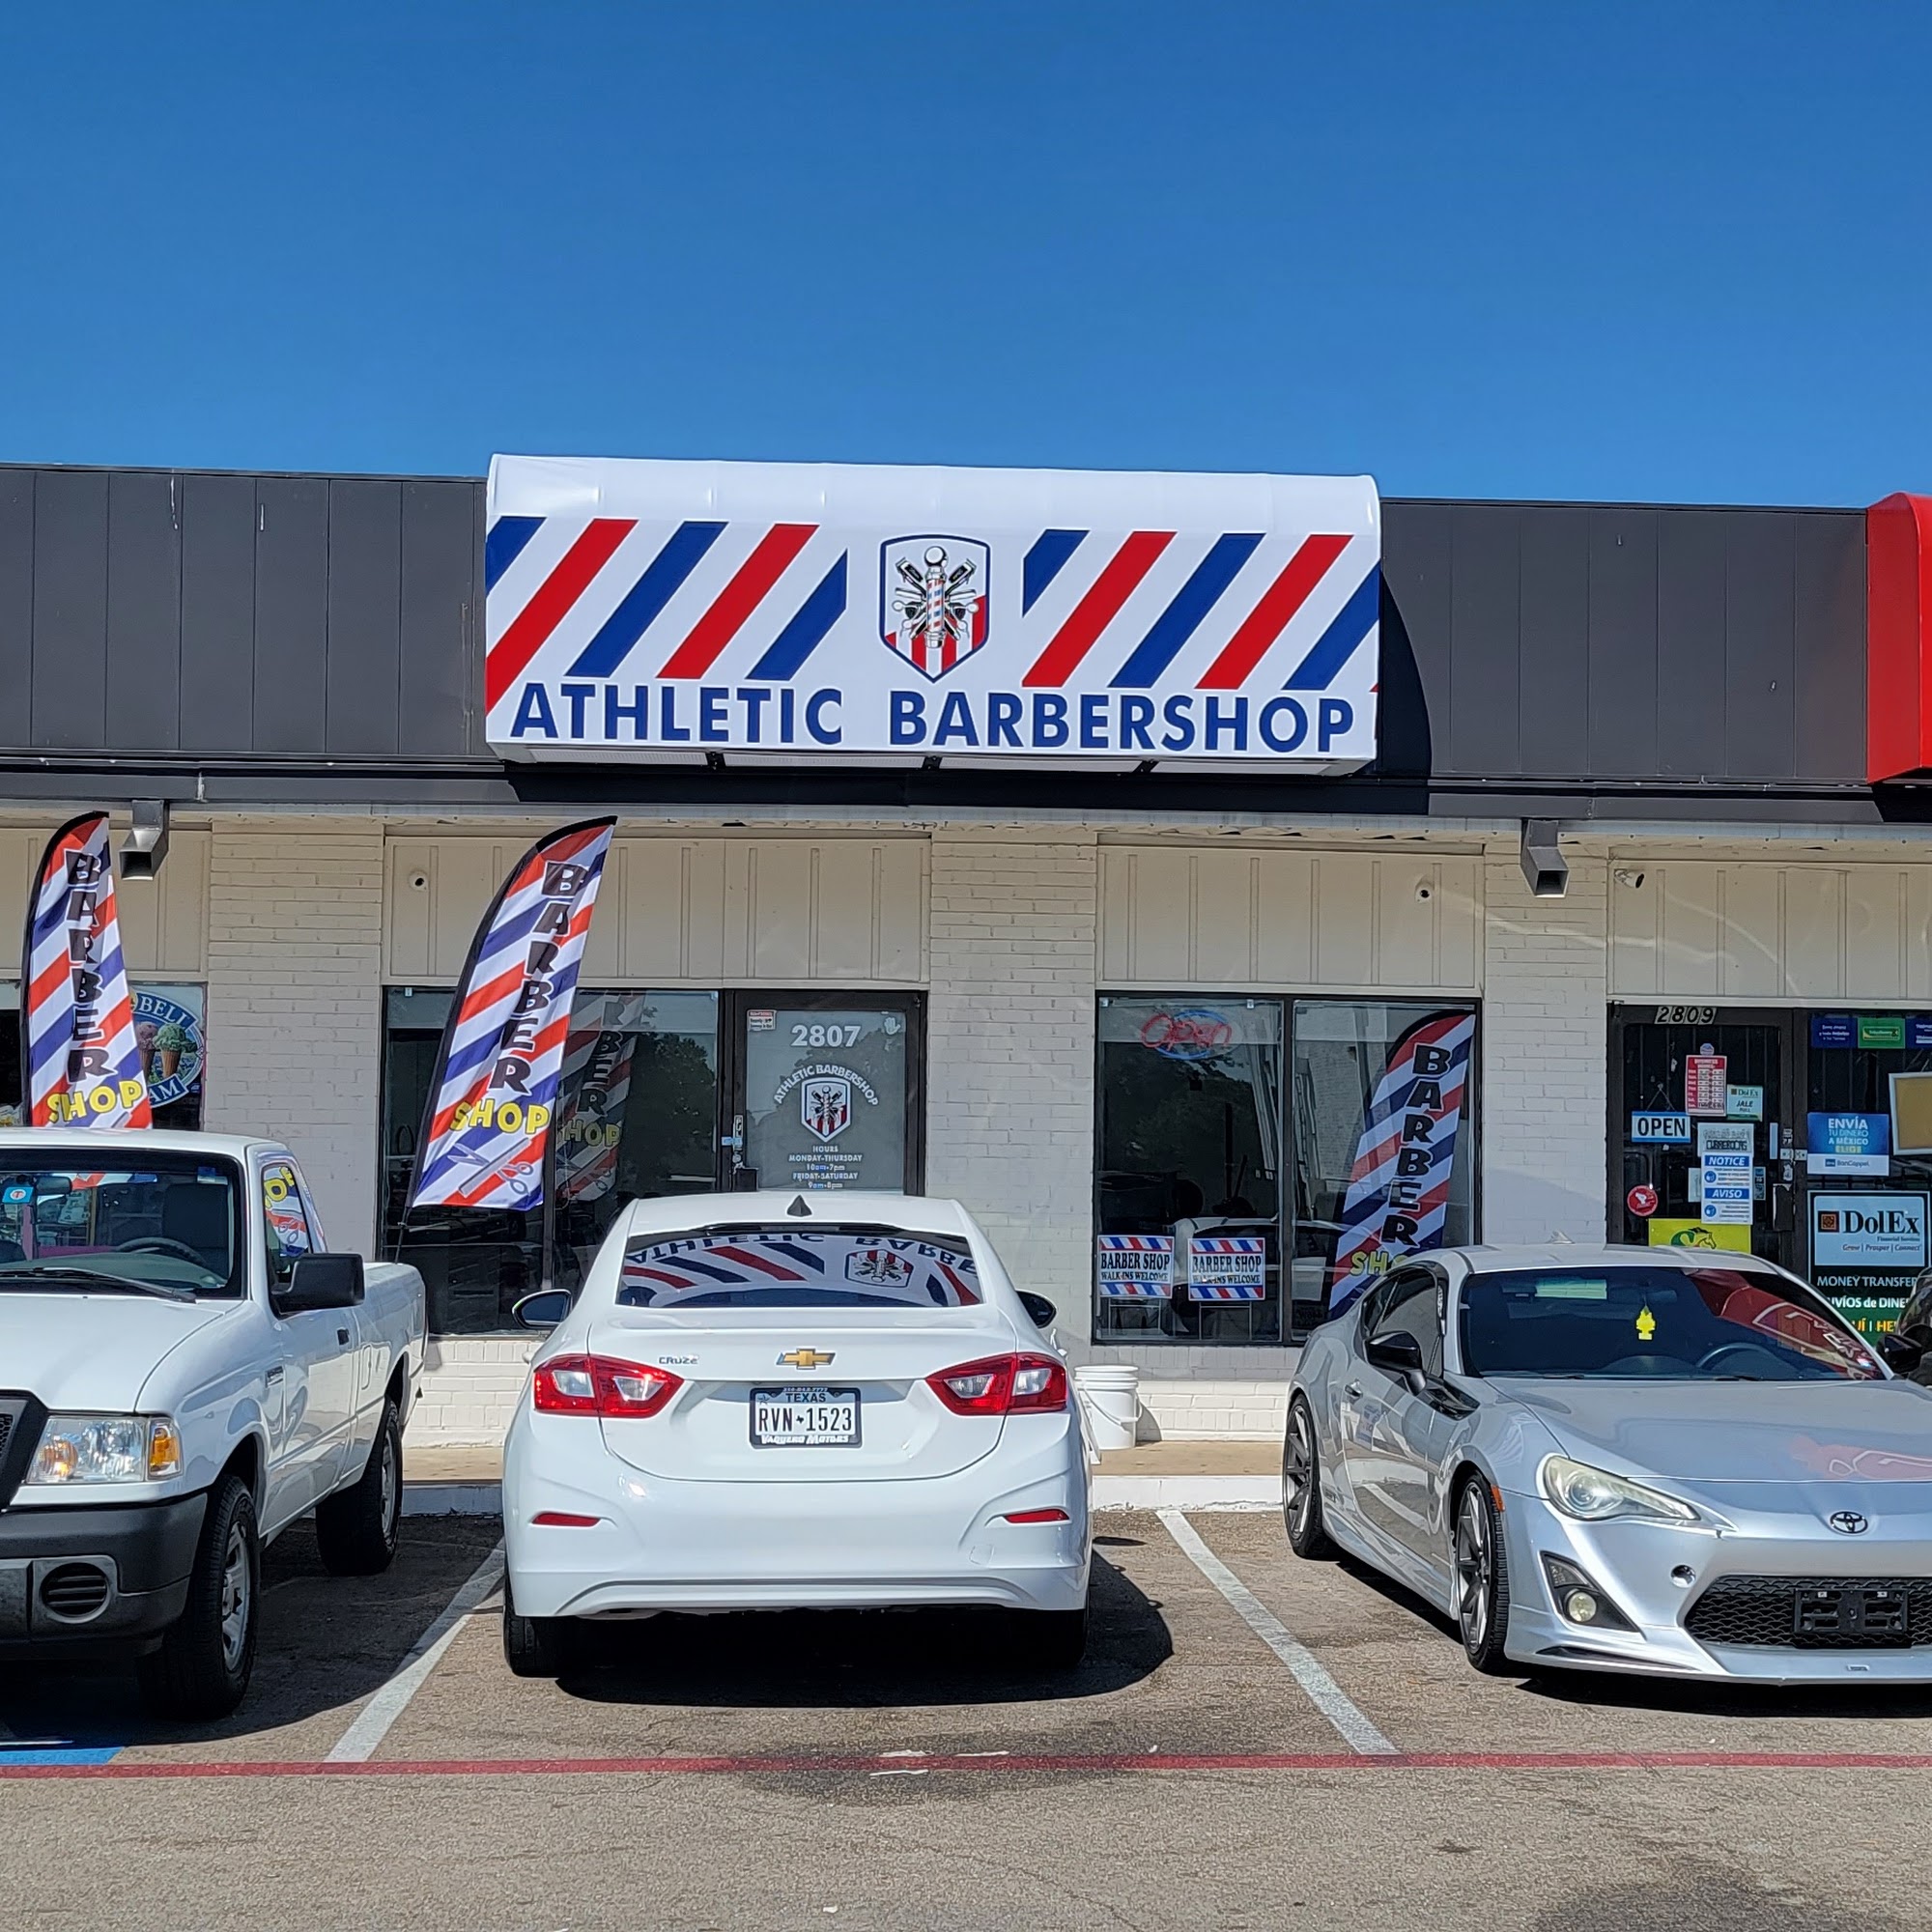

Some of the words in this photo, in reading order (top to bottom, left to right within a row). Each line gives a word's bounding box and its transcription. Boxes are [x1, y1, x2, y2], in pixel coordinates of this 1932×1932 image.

[510, 682, 842, 745] ATHLETIC
[889, 690, 1354, 753] BARBERSHOP
[65, 848, 118, 1084] BARBER
[488, 861, 589, 1095] BARBER
[1656, 1006, 1715, 1024] 2809
[789, 1024, 862, 1047] 2807
[773, 1065, 816, 1105] ATHLETIC
[815, 1064, 879, 1106] BARBERSHOP
[46, 1079, 144, 1124] SHOP
[448, 1098, 551, 1135] SHOP
[1828, 1116, 1868, 1130] ENVÍA
[1637, 1117, 1686, 1138] OPEN
[1381, 1043, 1452, 1248] BARBER
[1708, 1156, 1746, 1166] NOTICE
[1712, 1189, 1743, 1199] AVISO
[1842, 1209, 1920, 1235] DolEx
[1100, 1252, 1141, 1269] BARBER
[1144, 1254, 1170, 1270] SHOP
[1192, 1256, 1233, 1273] BARBER
[1235, 1256, 1262, 1273] SHOP
[1135, 1272, 1168, 1281] WELCOME
[1227, 1275, 1261, 1284] WELCOME
[1817, 1275, 1861, 1287] MONEY
[1863, 1296, 1877, 1308] de
[785, 1392, 826, 1403] TEXAS
[758, 1407, 792, 1432] RVN
[806, 1407, 851, 1432] 1523
[761, 1435, 806, 1444] VAQUERO
[806, 1435, 849, 1444] MOTORS
